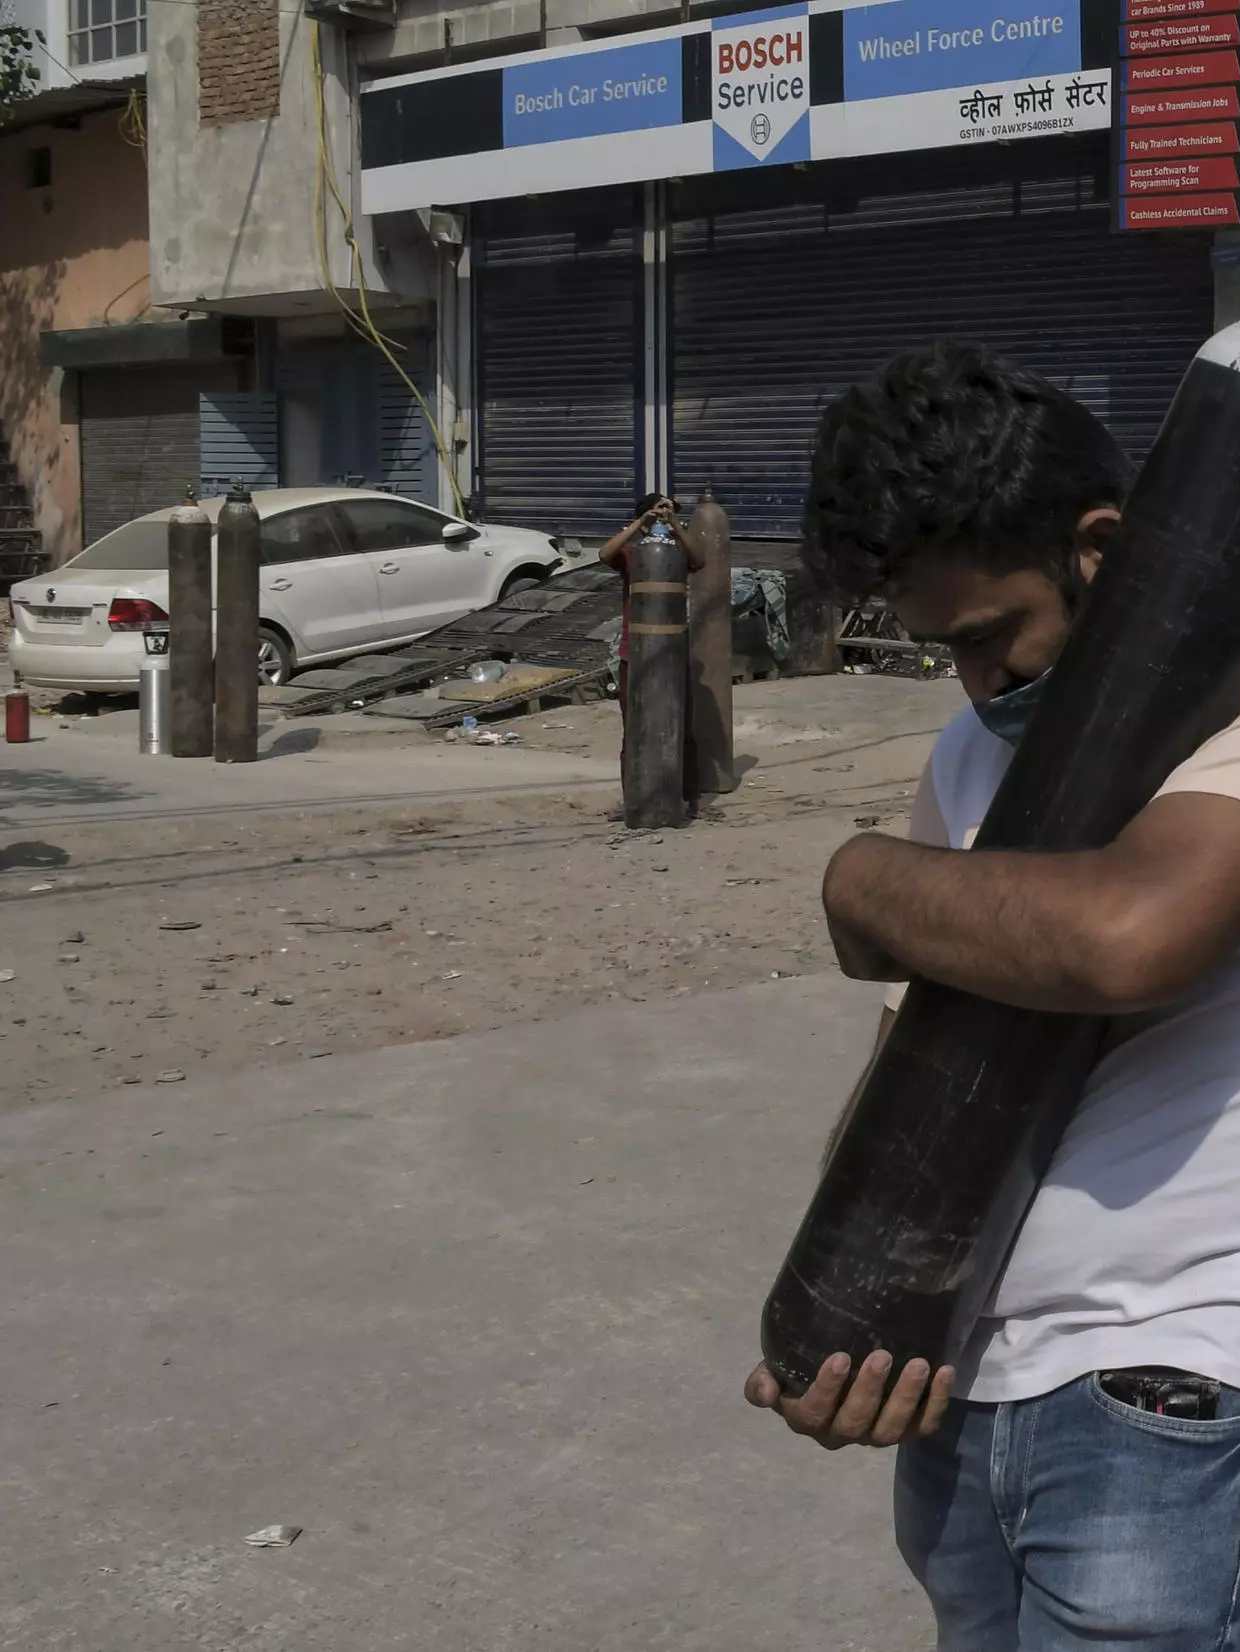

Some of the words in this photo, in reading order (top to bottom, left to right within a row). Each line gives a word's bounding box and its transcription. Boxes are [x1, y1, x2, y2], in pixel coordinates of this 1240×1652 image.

[1143, 6, 1166, 15] Brands
[1167, 4, 1186, 12] Since
[1150, 28, 1166, 36] 40%
[1167, 25, 1199, 35] Discount
[858, 31, 921, 63] Wheel
[927, 27, 985, 52] Force
[990, 15, 1064, 43] Centre
[1130, 40, 1159, 50] Original
[1161, 38, 1180, 47] Parts
[1181, 35, 1197, 45] with
[1199, 33, 1231, 43] Warranty
[718, 31, 803, 74] BOSCH
[1132, 68, 1161, 79] Periodic
[1161, 67, 1175, 76] Car
[1175, 65, 1205, 75] Services
[514, 88, 564, 115] Bosch
[568, 83, 598, 108] Car
[602, 73, 668, 104] Service
[717, 74, 805, 111] Service
[959, 89, 1003, 123] व्हील
[1065, 76, 1108, 109] सेंटर
[1130, 104, 1156, 115] Engine
[1157, 103, 1164, 111] &
[1165, 99, 1212, 111] Transmission
[1212, 98, 1229, 108] Jobs
[959, 127, 985, 139] GSTIN
[1130, 140, 1149, 150] Fully
[1149, 138, 1177, 148] Trained
[1178, 136, 1222, 146] Technicians
[1130, 167, 1153, 177] Latest
[1154, 165, 1187, 175] Software
[1187, 164, 1199, 173] for
[1130, 178, 1180, 189] Programming
[1181, 176, 1199, 185] Scan
[1130, 210, 1162, 220] Cashless
[1163, 207, 1202, 218] Accidental
[1203, 206, 1228, 216] Claims
